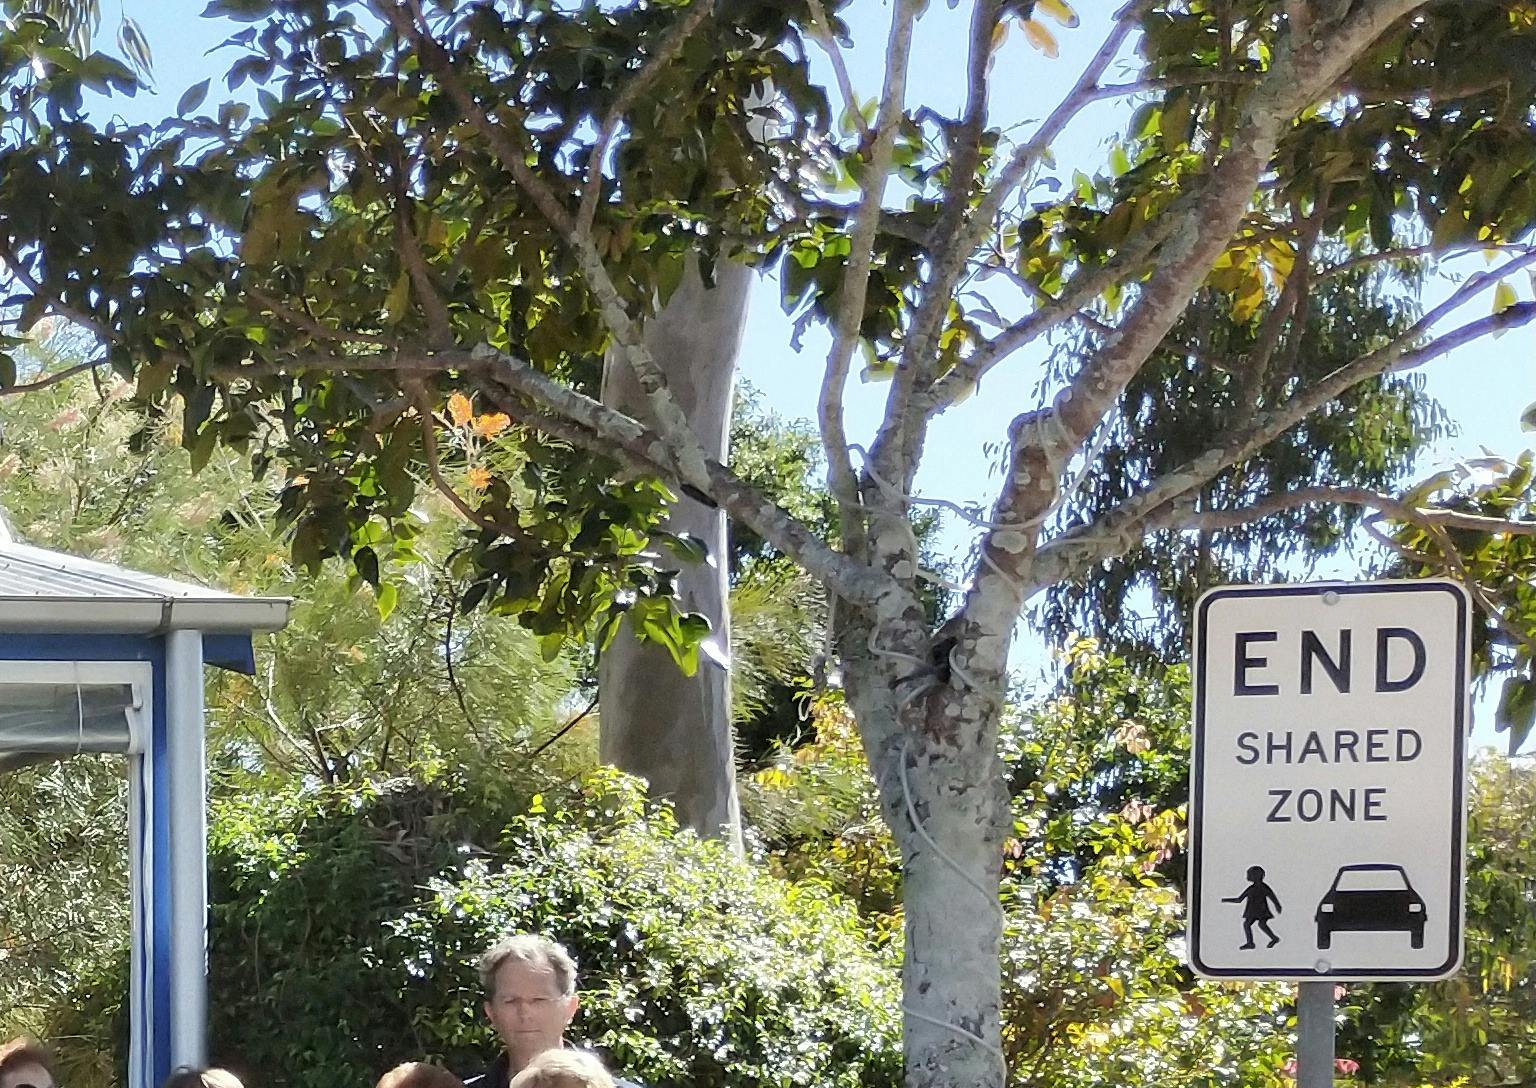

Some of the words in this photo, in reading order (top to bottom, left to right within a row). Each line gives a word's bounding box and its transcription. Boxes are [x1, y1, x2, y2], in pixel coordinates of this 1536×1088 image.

[1234, 627, 1428, 697] END
[1235, 728, 1423, 765] SHARED
[1266, 787, 1389, 823] ZONE
